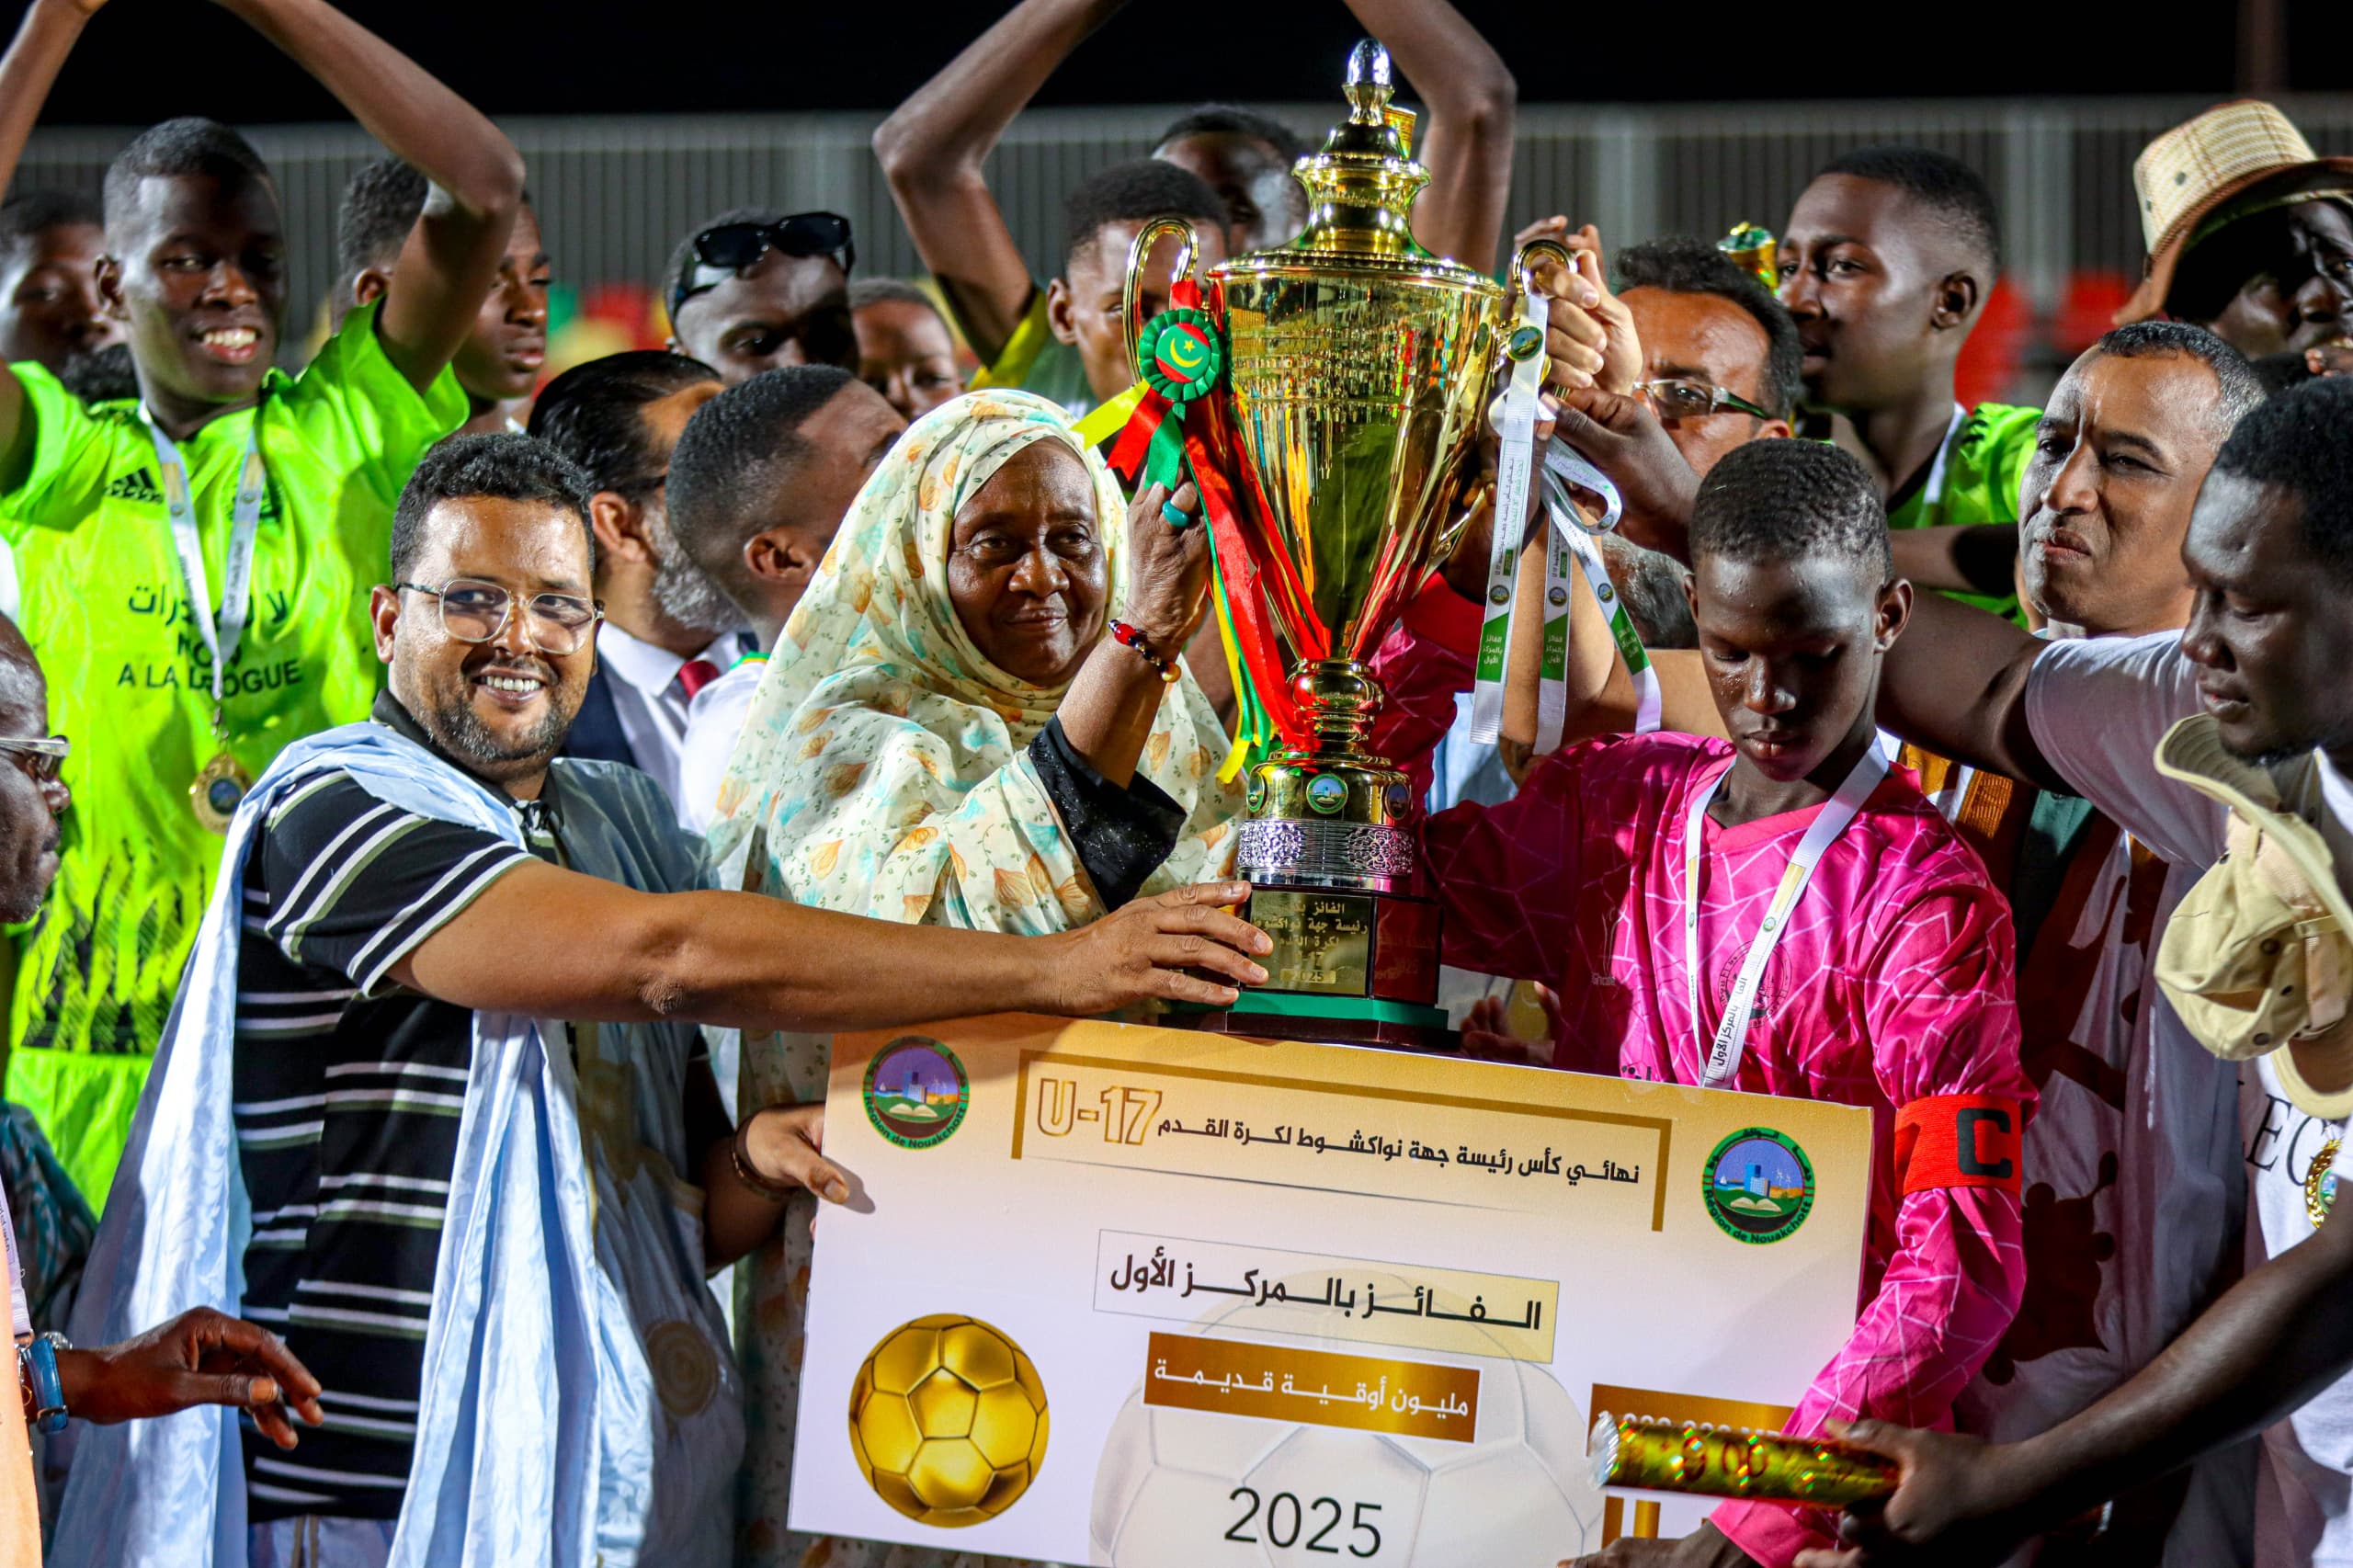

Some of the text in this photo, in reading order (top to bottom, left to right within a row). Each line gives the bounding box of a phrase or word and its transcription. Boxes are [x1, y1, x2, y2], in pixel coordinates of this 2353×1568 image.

[117, 662, 137, 687] A
[145, 664, 180, 689] LA
[1037, 1077, 1641, 1187] نهائي كأس رئيسة جهة نواكشوط لكرة القدم U-17
[1955, 1107, 2014, 1179] C
[1750, 1201, 1812, 1244] Nouakchott
[1109, 1245, 1542, 1331] الفائز بالمركز الأول
[1154, 1358, 1470, 1420] مليون أوقية قديمة
[1223, 1486, 1383, 1559] 2025
